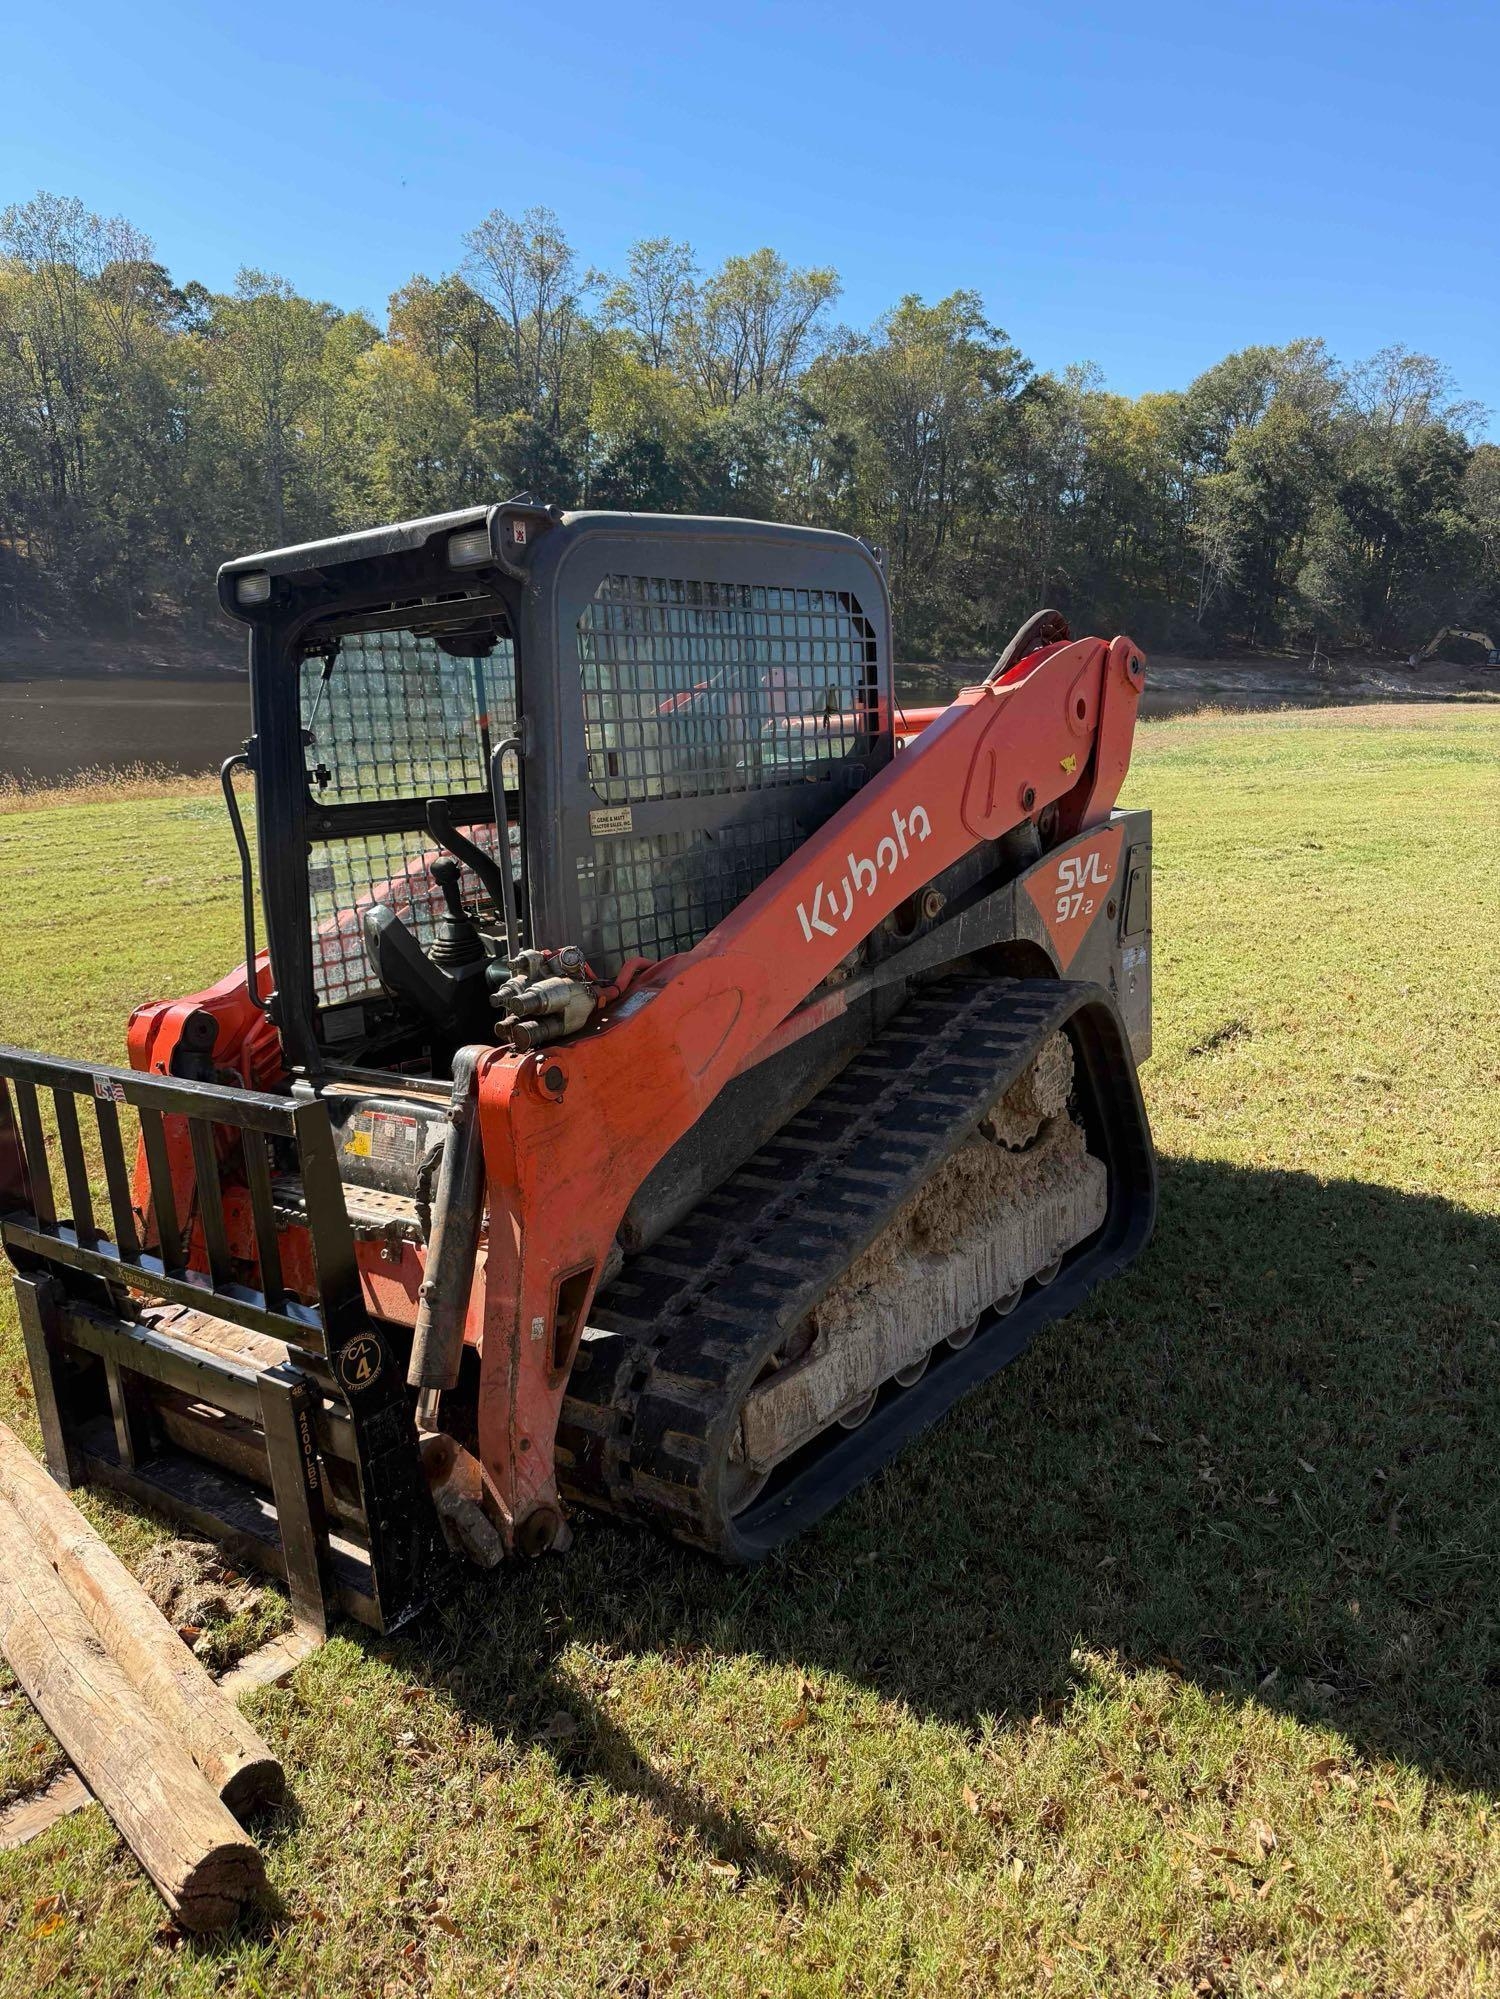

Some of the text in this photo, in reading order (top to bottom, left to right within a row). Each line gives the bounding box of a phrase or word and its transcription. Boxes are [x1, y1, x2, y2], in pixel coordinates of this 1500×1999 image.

[796, 805, 932, 943] Kubota
[1055, 852, 1108, 894] SVL
[95, 1083, 115, 1100] USA
[298, 1410, 318, 1490] 4200 LBS
